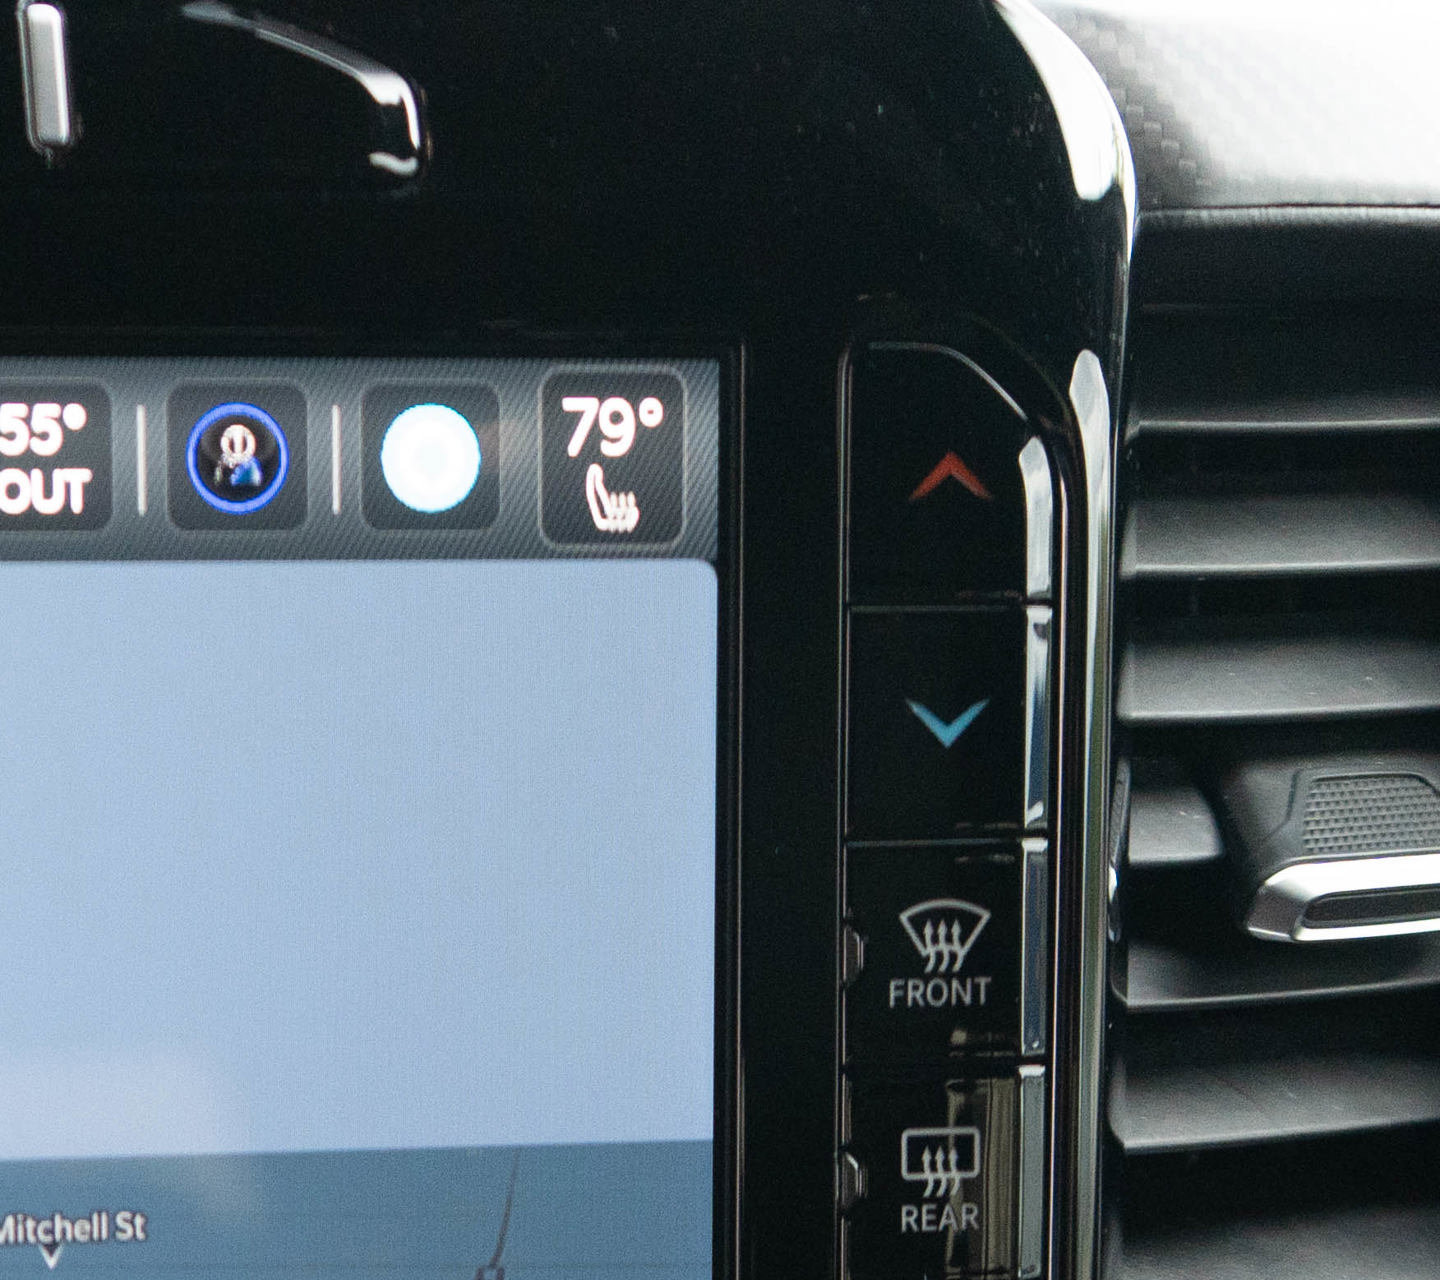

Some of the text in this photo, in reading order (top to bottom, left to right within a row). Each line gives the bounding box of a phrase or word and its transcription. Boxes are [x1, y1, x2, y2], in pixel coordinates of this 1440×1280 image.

[889, 977, 992, 1009] FRONT
[115, 1210, 146, 1241] St
[900, 1205, 979, 1233] REAR
